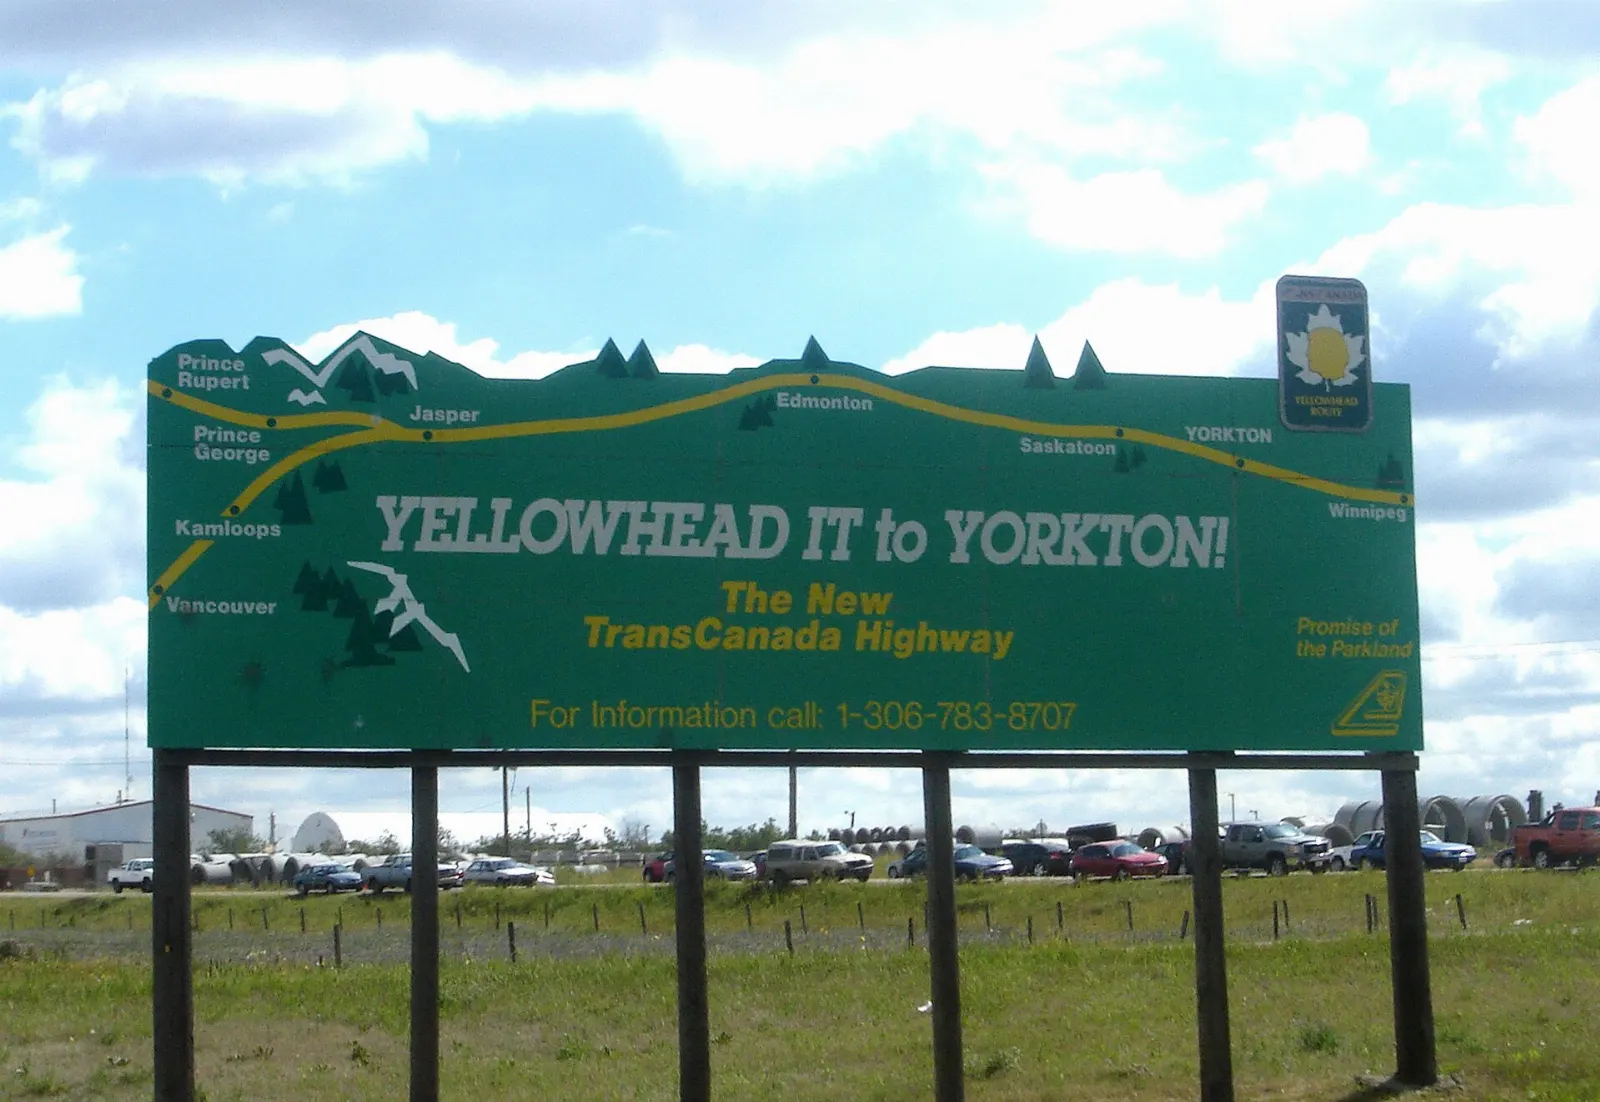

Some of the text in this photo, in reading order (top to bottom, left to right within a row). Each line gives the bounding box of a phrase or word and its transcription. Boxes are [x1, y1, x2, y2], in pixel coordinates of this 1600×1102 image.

[178, 353, 245, 372] Prince
[178, 371, 250, 391] Rupert
[776, 391, 874, 411] Edmonton
[409, 405, 480, 425] Jasper
[193, 425, 262, 443] Prince
[1186, 427, 1273, 444] YORKTON
[194, 444, 270, 465] George
[1020, 437, 1117, 456] Saskatoon
[1329, 502, 1408, 523] Winnipeg
[175, 520, 282, 539] Kamloops
[376, 496, 1230, 568] YELLOWHEAD IT to YORKTON!
[166, 597, 277, 615] Vancouver
[721, 581, 893, 615] The New
[1297, 617, 1400, 636] Promise of
[584, 615, 1014, 660] TransCanada Highway
[1297, 640, 1414, 658] the Parkland
[530, 699, 1077, 730] For Information call: 1-306-783-8707
